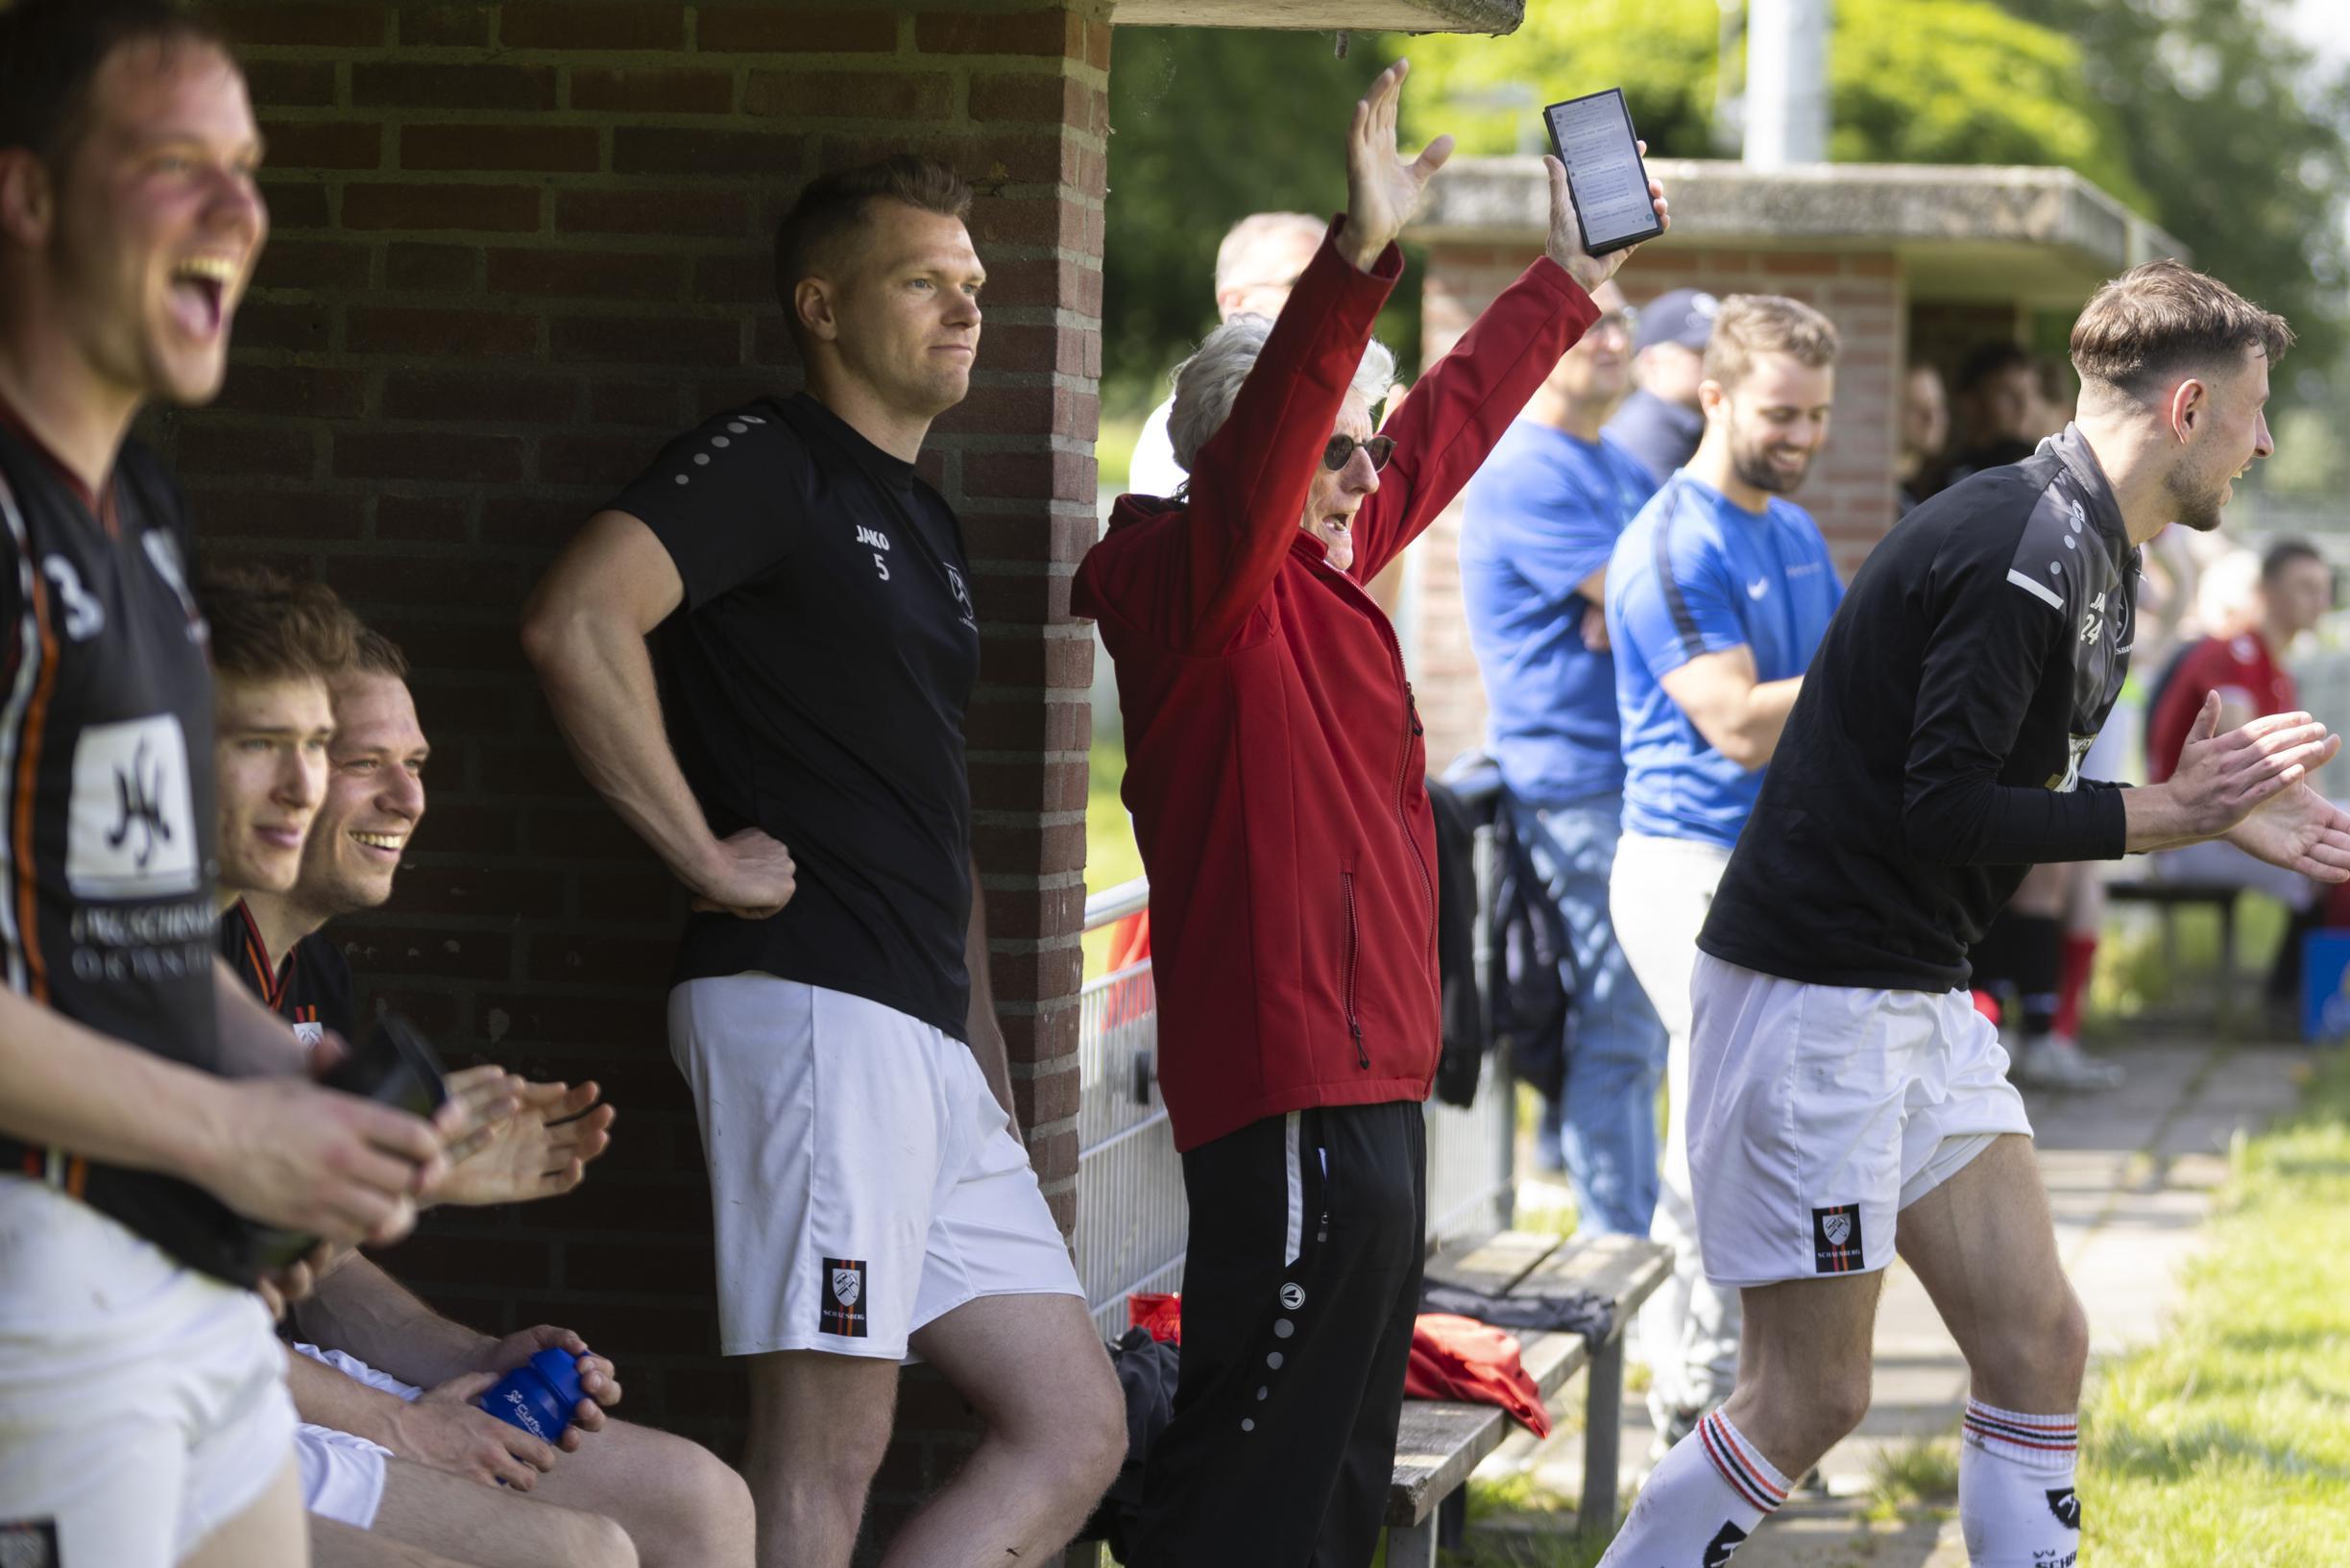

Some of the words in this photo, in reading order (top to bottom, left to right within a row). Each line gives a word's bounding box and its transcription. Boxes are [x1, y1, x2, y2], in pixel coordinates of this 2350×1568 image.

[856, 524, 889, 550] JAKO
[873, 553, 889, 581] 5
[42, 553, 106, 641] 3
[2080, 614, 2103, 645] 24
